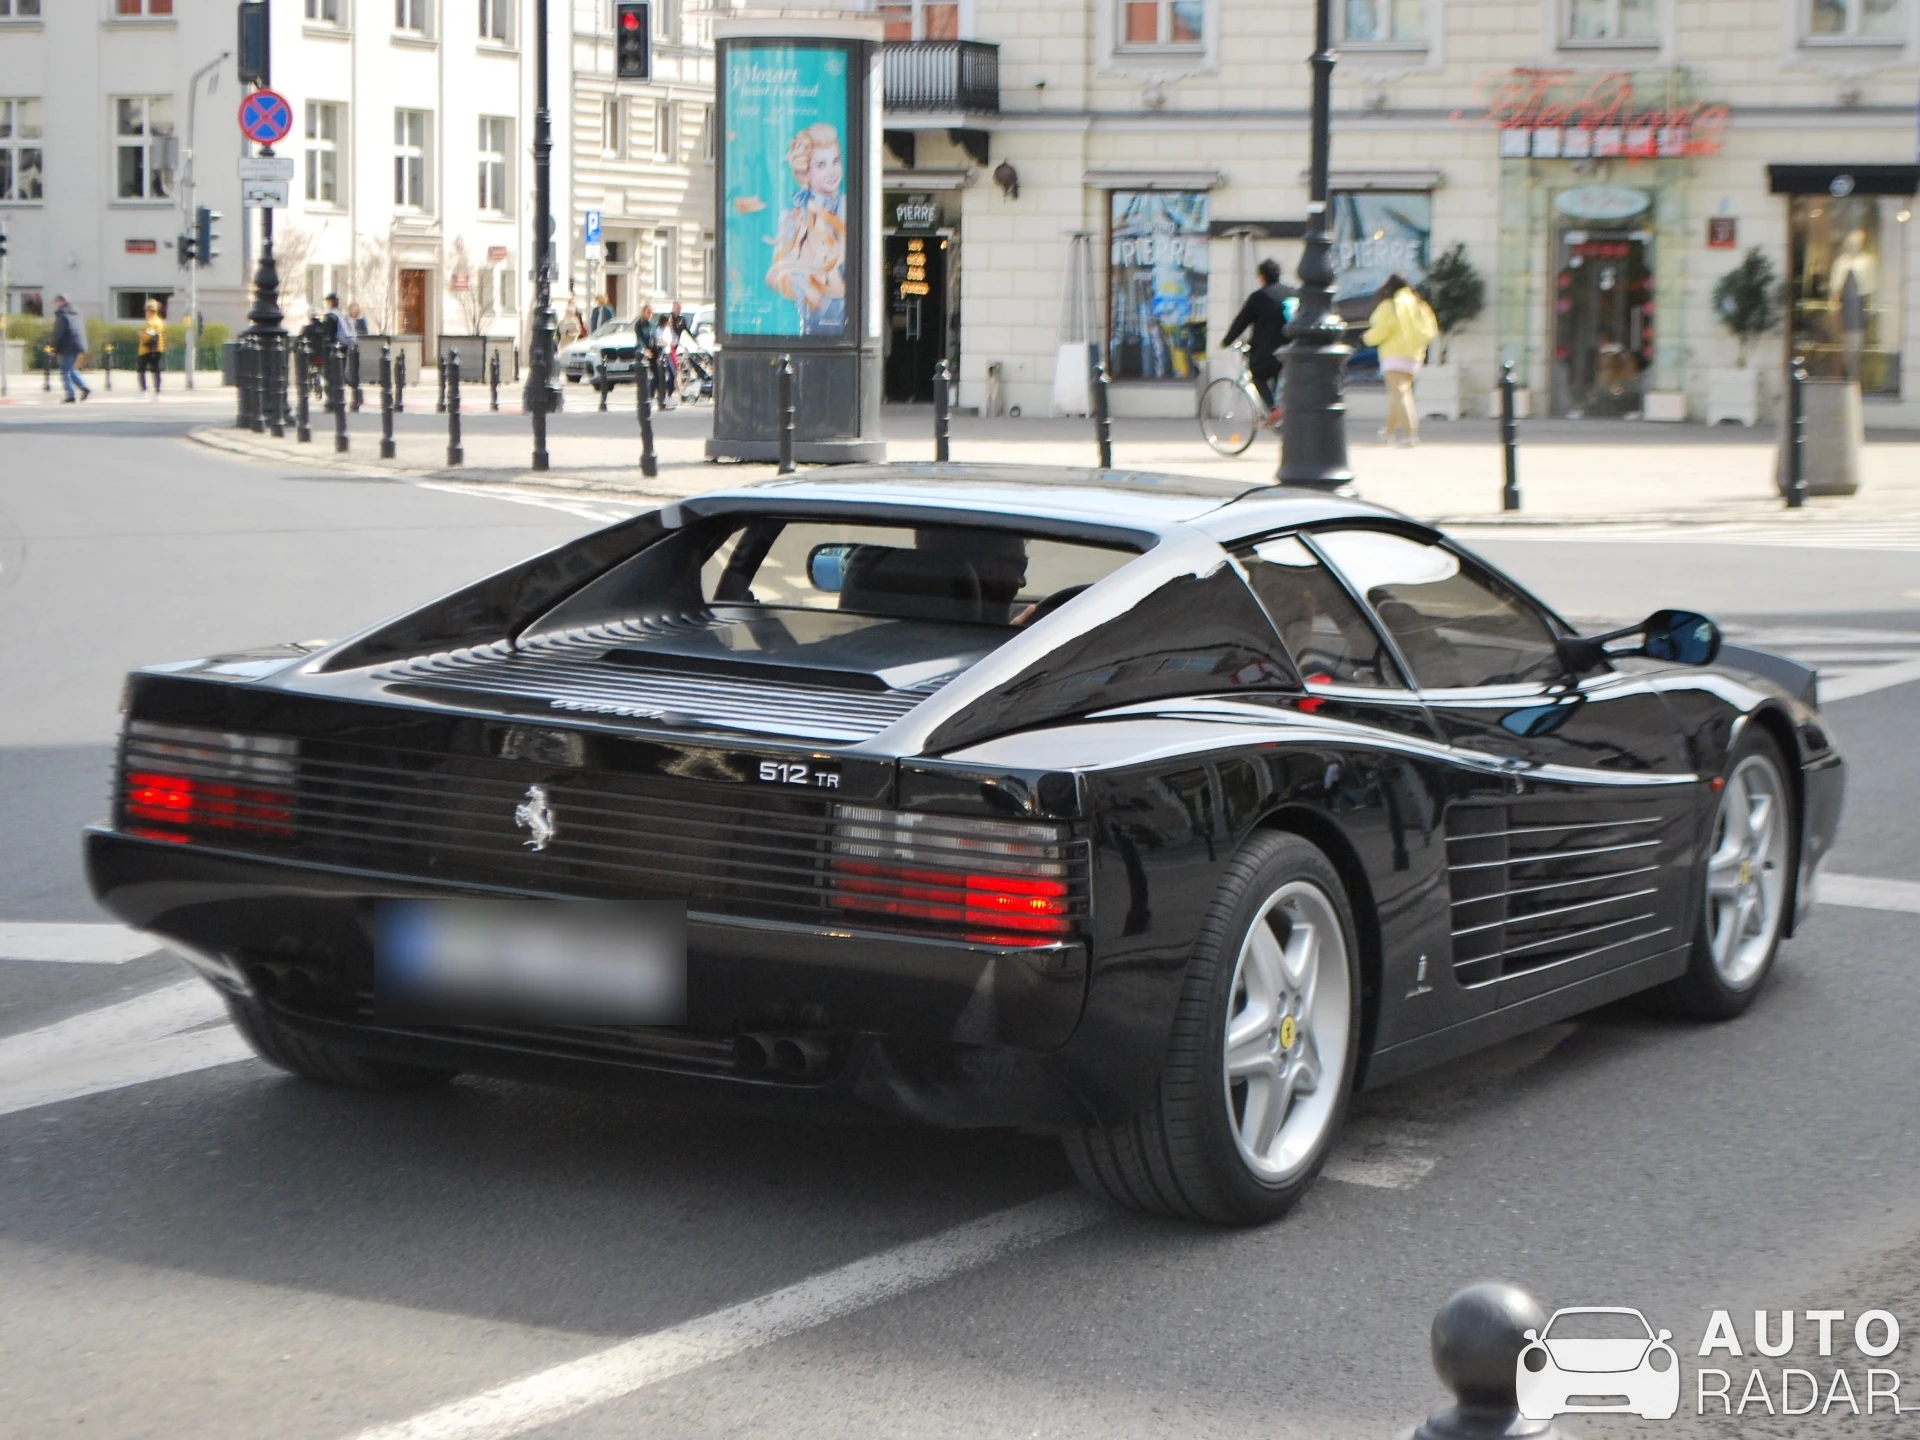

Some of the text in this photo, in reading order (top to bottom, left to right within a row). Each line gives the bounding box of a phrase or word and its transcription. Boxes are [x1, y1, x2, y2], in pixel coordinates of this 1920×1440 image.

[743, 62, 799, 83] Mozart
[896, 205, 936, 222] PIERRE
[1120, 239, 1196, 269] PIERRE
[759, 762, 839, 788] 512 TR
